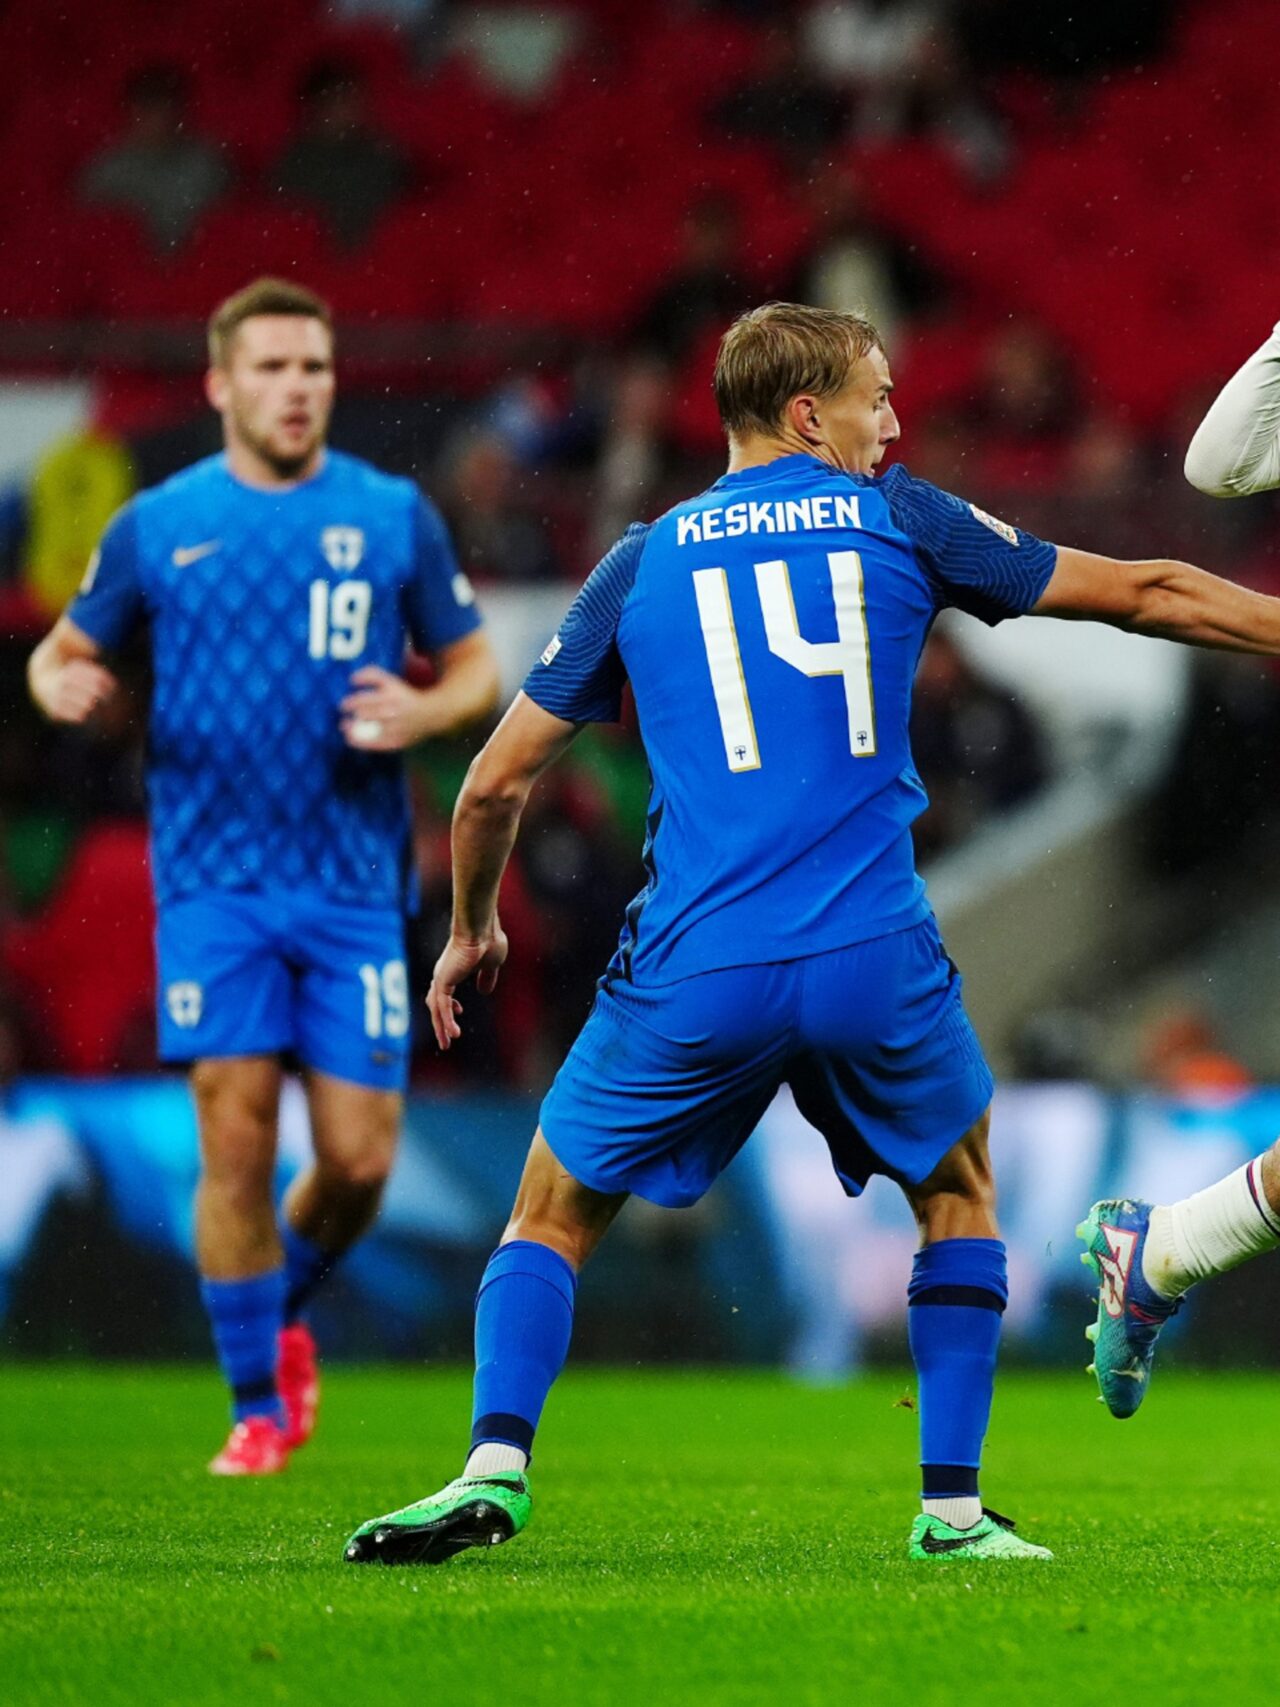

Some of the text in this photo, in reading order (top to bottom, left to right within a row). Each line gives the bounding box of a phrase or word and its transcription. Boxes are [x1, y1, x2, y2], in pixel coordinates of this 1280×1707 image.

[677, 495, 862, 546] KESKINEN
[309, 579, 372, 660] 19
[692, 550, 877, 774] 14
[359, 960, 410, 1039] 19
